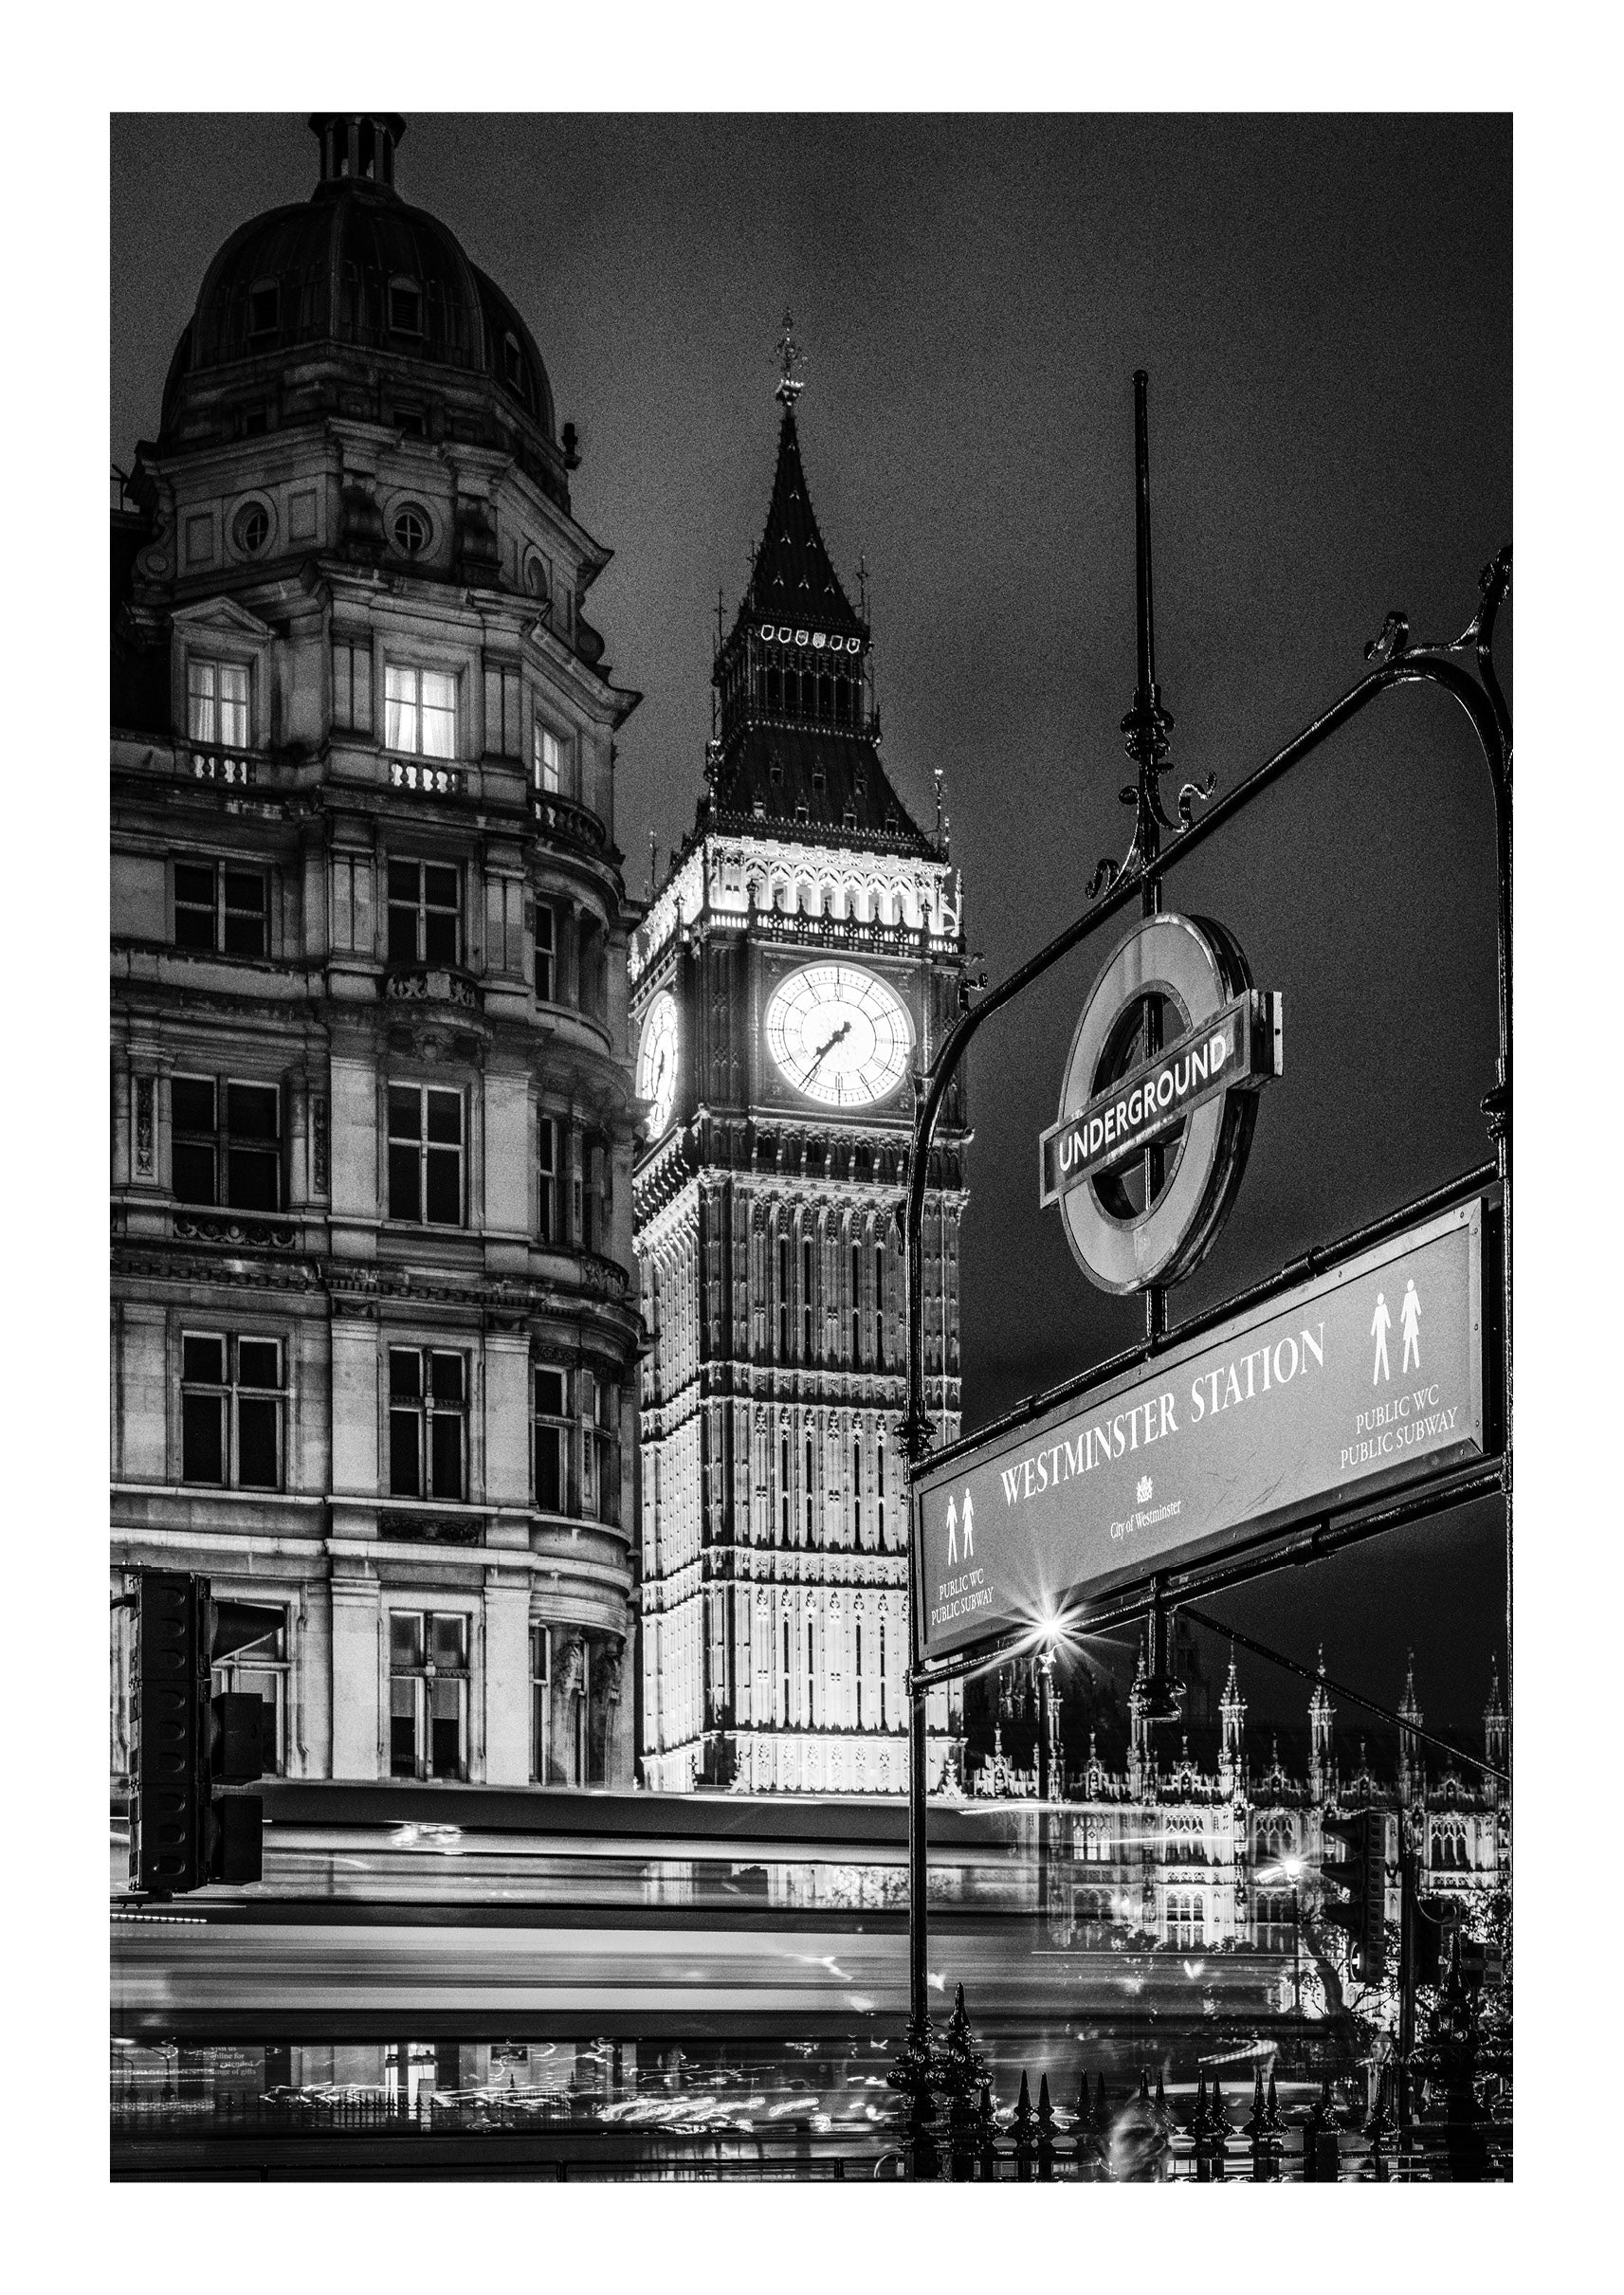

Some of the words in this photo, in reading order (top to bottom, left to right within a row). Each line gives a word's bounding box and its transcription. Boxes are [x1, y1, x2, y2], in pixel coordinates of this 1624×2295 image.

[1059, 1034, 1227, 1172] UNDERGROUND
[1000, 1392, 1179, 1506] WESTMINSTER
[1191, 1321, 1326, 1424] STATION
[1356, 1395, 1410, 1435] PUBLIC
[1413, 1384, 1439, 1412] WC
[1341, 1431, 1394, 1469] PUBLIC
[1396, 1406, 1458, 1449] SUBWAY
[1110, 1521, 1125, 1540] City
[1125, 1514, 1135, 1533] of
[1135, 1500, 1181, 1529] Westminster
[931, 1600, 960, 1626] PUBLIC
[960, 1586, 994, 1614] SUBWAY
[939, 1575, 969, 1601] PUBLIC
[969, 1568, 984, 1588] WC
